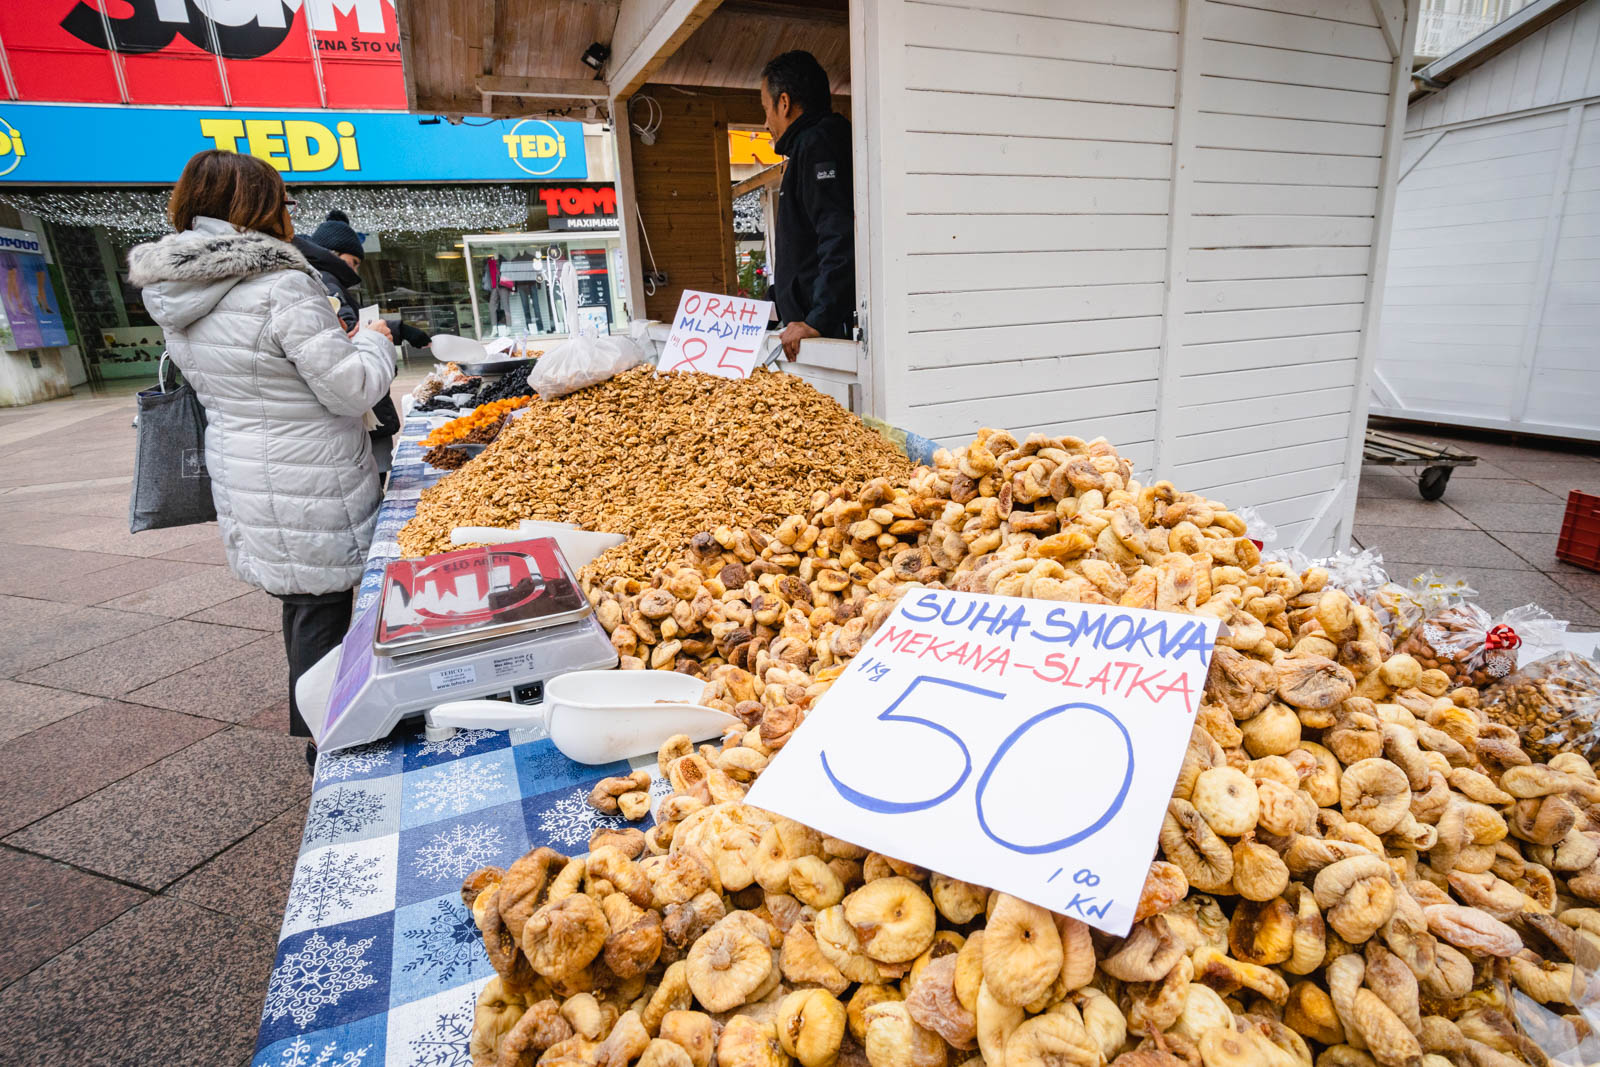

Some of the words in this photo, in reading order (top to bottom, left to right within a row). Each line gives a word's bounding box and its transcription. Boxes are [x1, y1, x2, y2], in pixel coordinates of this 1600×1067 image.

[314, 40, 347, 51] ZNA
[351, 37, 382, 52] ŠTO
[200, 119, 361, 171] TEDi
[503, 135, 566, 158] TEDi
[539, 187, 617, 216] TOM
[684, 294, 758, 324] ORAH
[901, 593, 1031, 641] SUHA
[1030, 607, 1216, 667] SMOKVA
[820, 674, 1136, 855] 50
